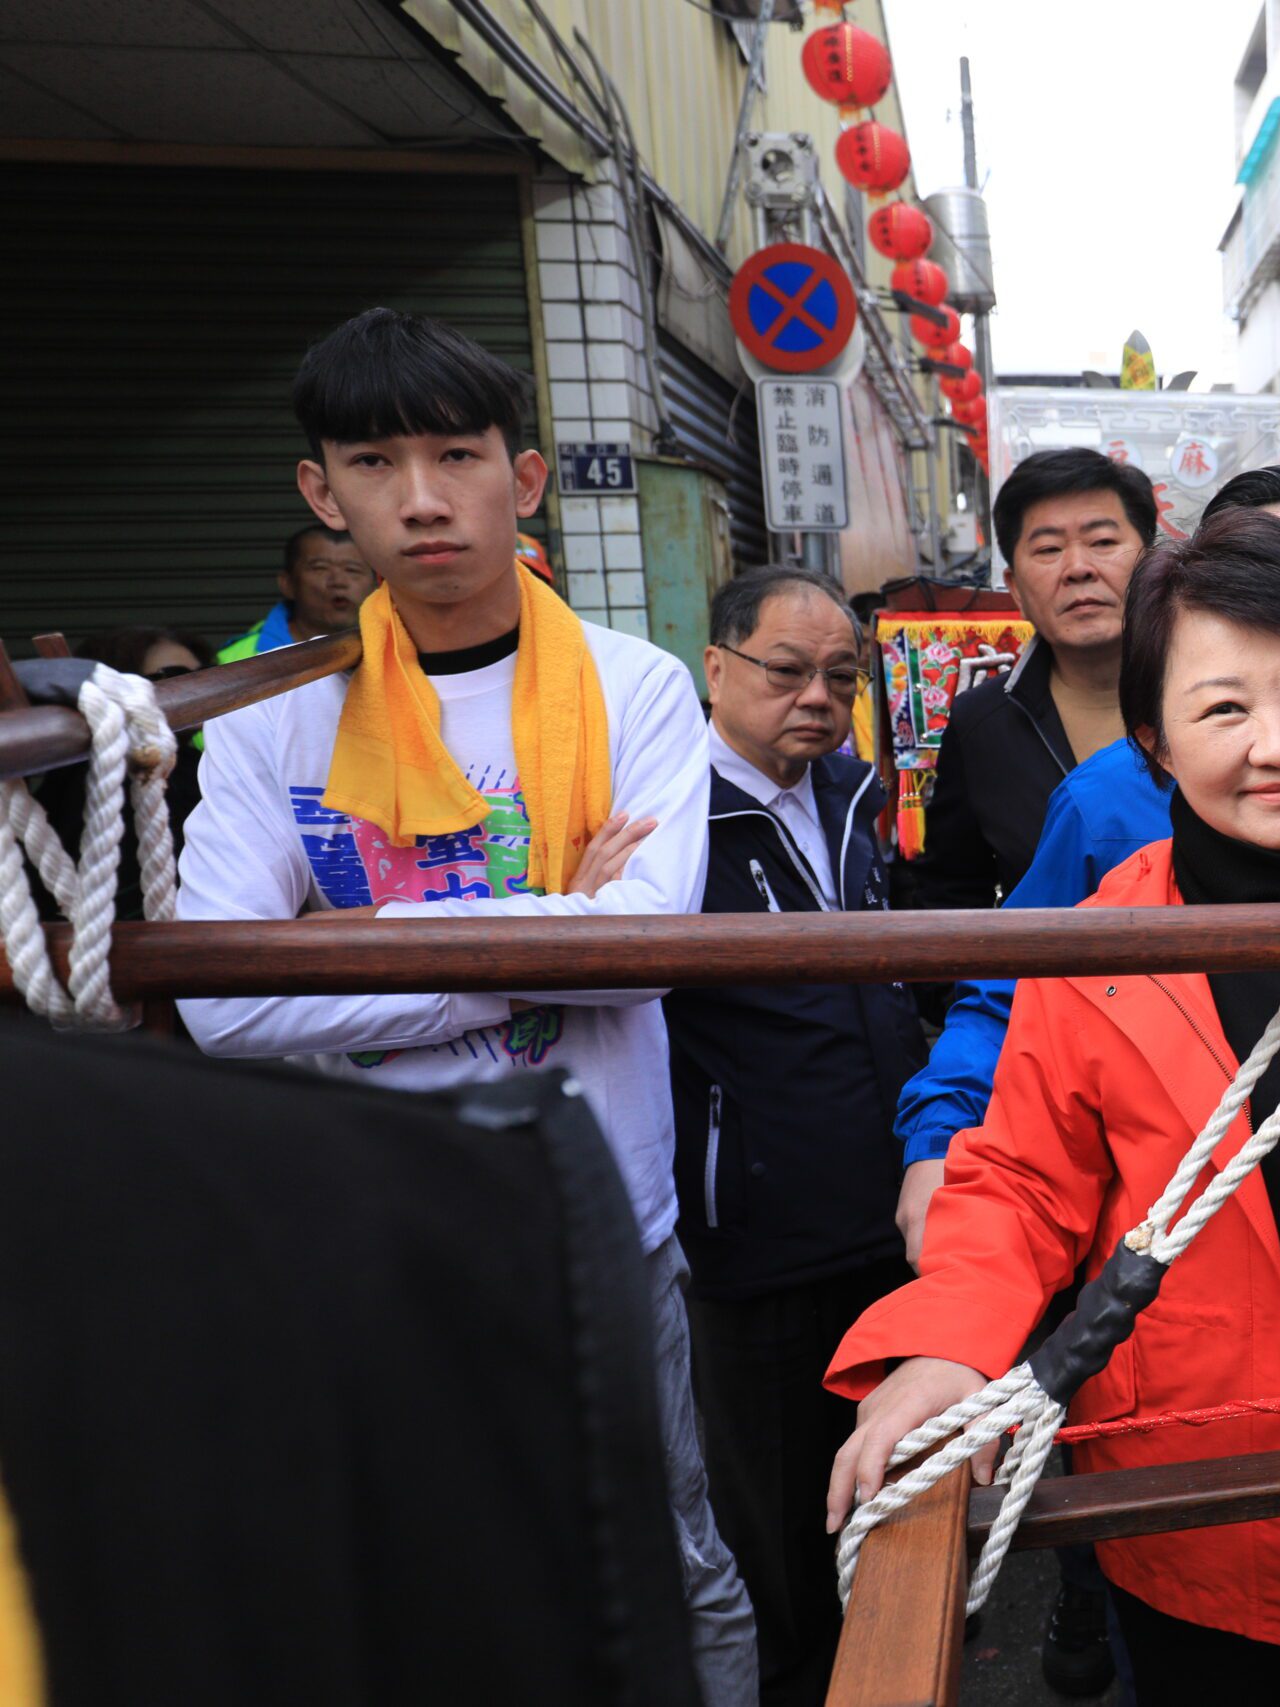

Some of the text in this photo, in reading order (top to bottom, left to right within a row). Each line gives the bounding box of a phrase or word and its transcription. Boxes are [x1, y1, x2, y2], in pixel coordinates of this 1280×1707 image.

[586, 457, 622, 487] 45
[773, 384, 804, 524] 禁止臨時停車
[805, 384, 836, 524] 消防通道
